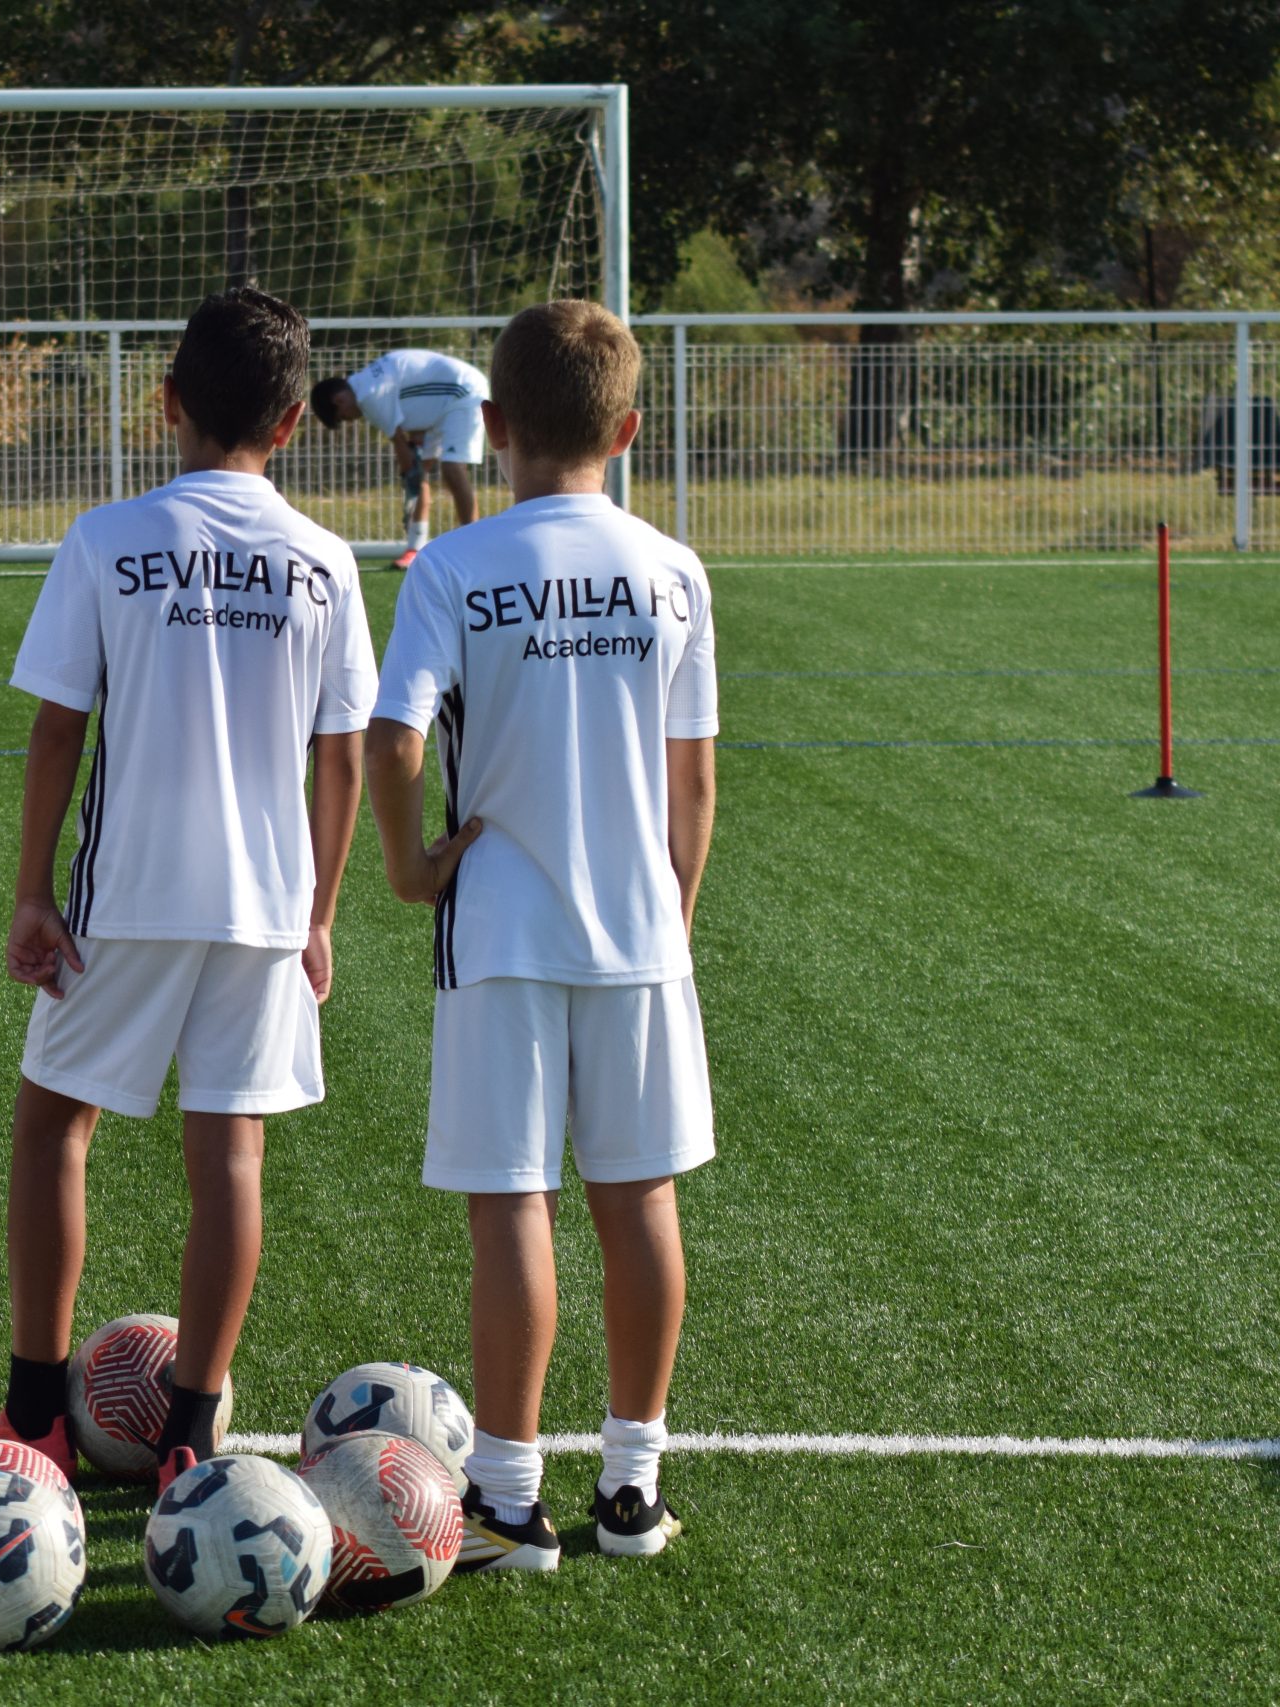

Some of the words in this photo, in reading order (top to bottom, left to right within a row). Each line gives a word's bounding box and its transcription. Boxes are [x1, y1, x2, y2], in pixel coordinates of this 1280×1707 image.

[115, 551, 273, 597] SEVILLA
[285, 558, 331, 606] FC
[166, 602, 288, 639] Academy
[466, 576, 638, 632] SEVILLA
[648, 577, 688, 622] FC
[522, 635, 654, 662] Academy
